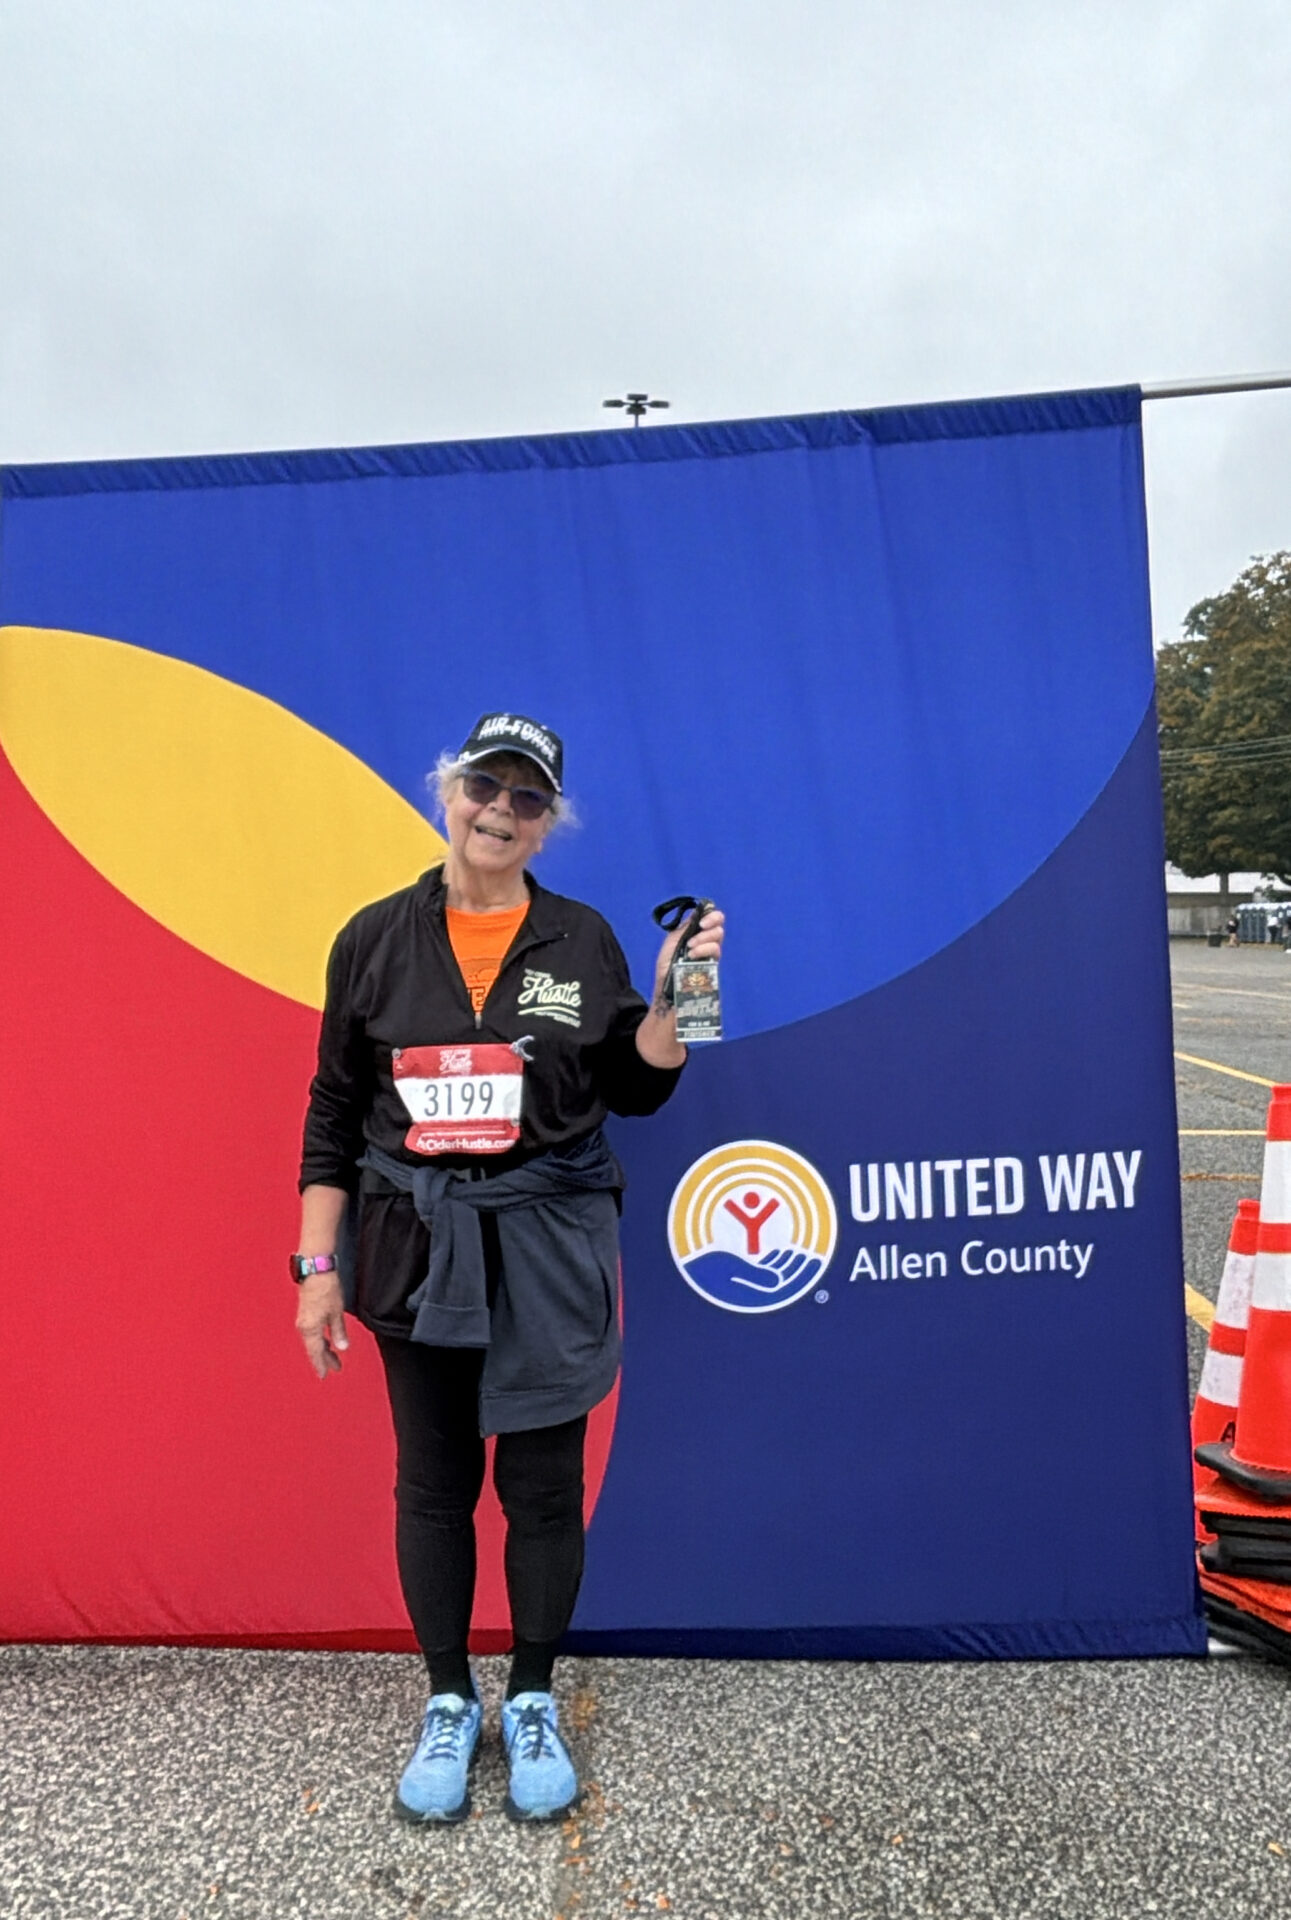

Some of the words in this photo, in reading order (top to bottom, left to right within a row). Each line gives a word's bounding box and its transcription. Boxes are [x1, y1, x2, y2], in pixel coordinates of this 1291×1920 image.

[478, 716, 509, 741] AIR
[511, 720, 557, 764] FORCE
[518, 976, 581, 1007] Hustle
[424, 1081, 493, 1117] 3199
[850, 1157, 1024, 1221] UNITED
[1039, 1151, 1141, 1211] WAY
[850, 1245, 946, 1281] Allen
[962, 1240, 1093, 1278] County
